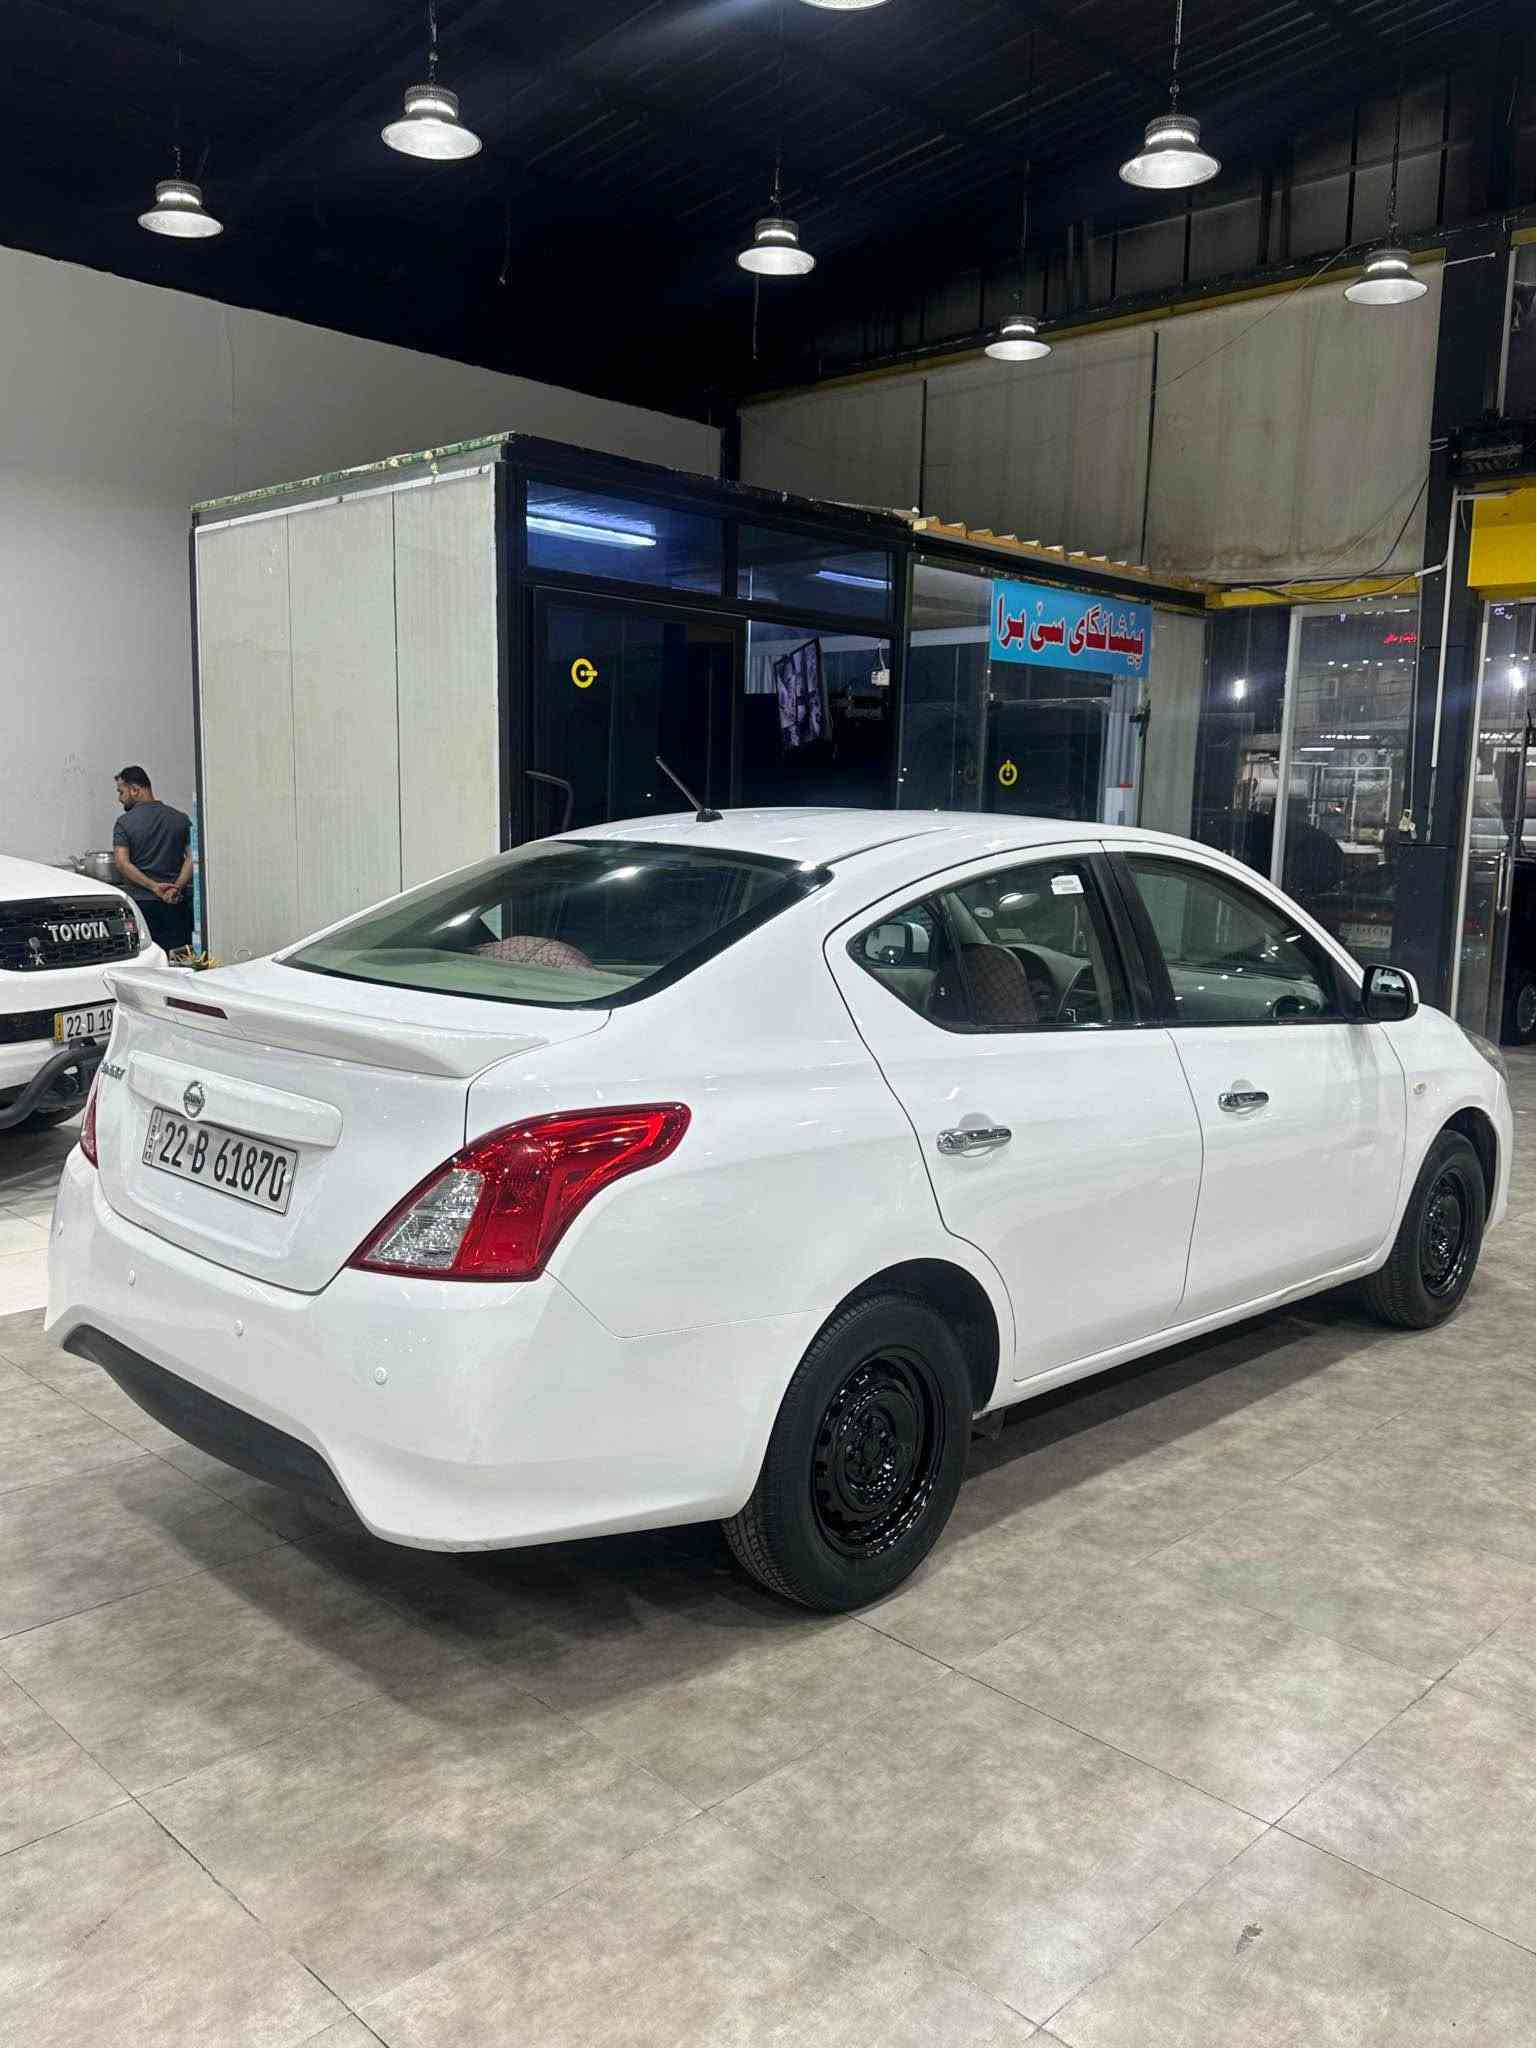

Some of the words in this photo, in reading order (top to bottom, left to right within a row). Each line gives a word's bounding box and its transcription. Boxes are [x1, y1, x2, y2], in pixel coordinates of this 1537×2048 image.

[998, 593, 1027, 649] برا
[48, 920, 110, 943] TOYOTA
[66, 1015, 82, 1038] 22
[86, 1012, 94, 1034] D
[158, 1121, 189, 1168] 22
[191, 1130, 209, 1174] B
[214, 1137, 287, 1202] 61870
